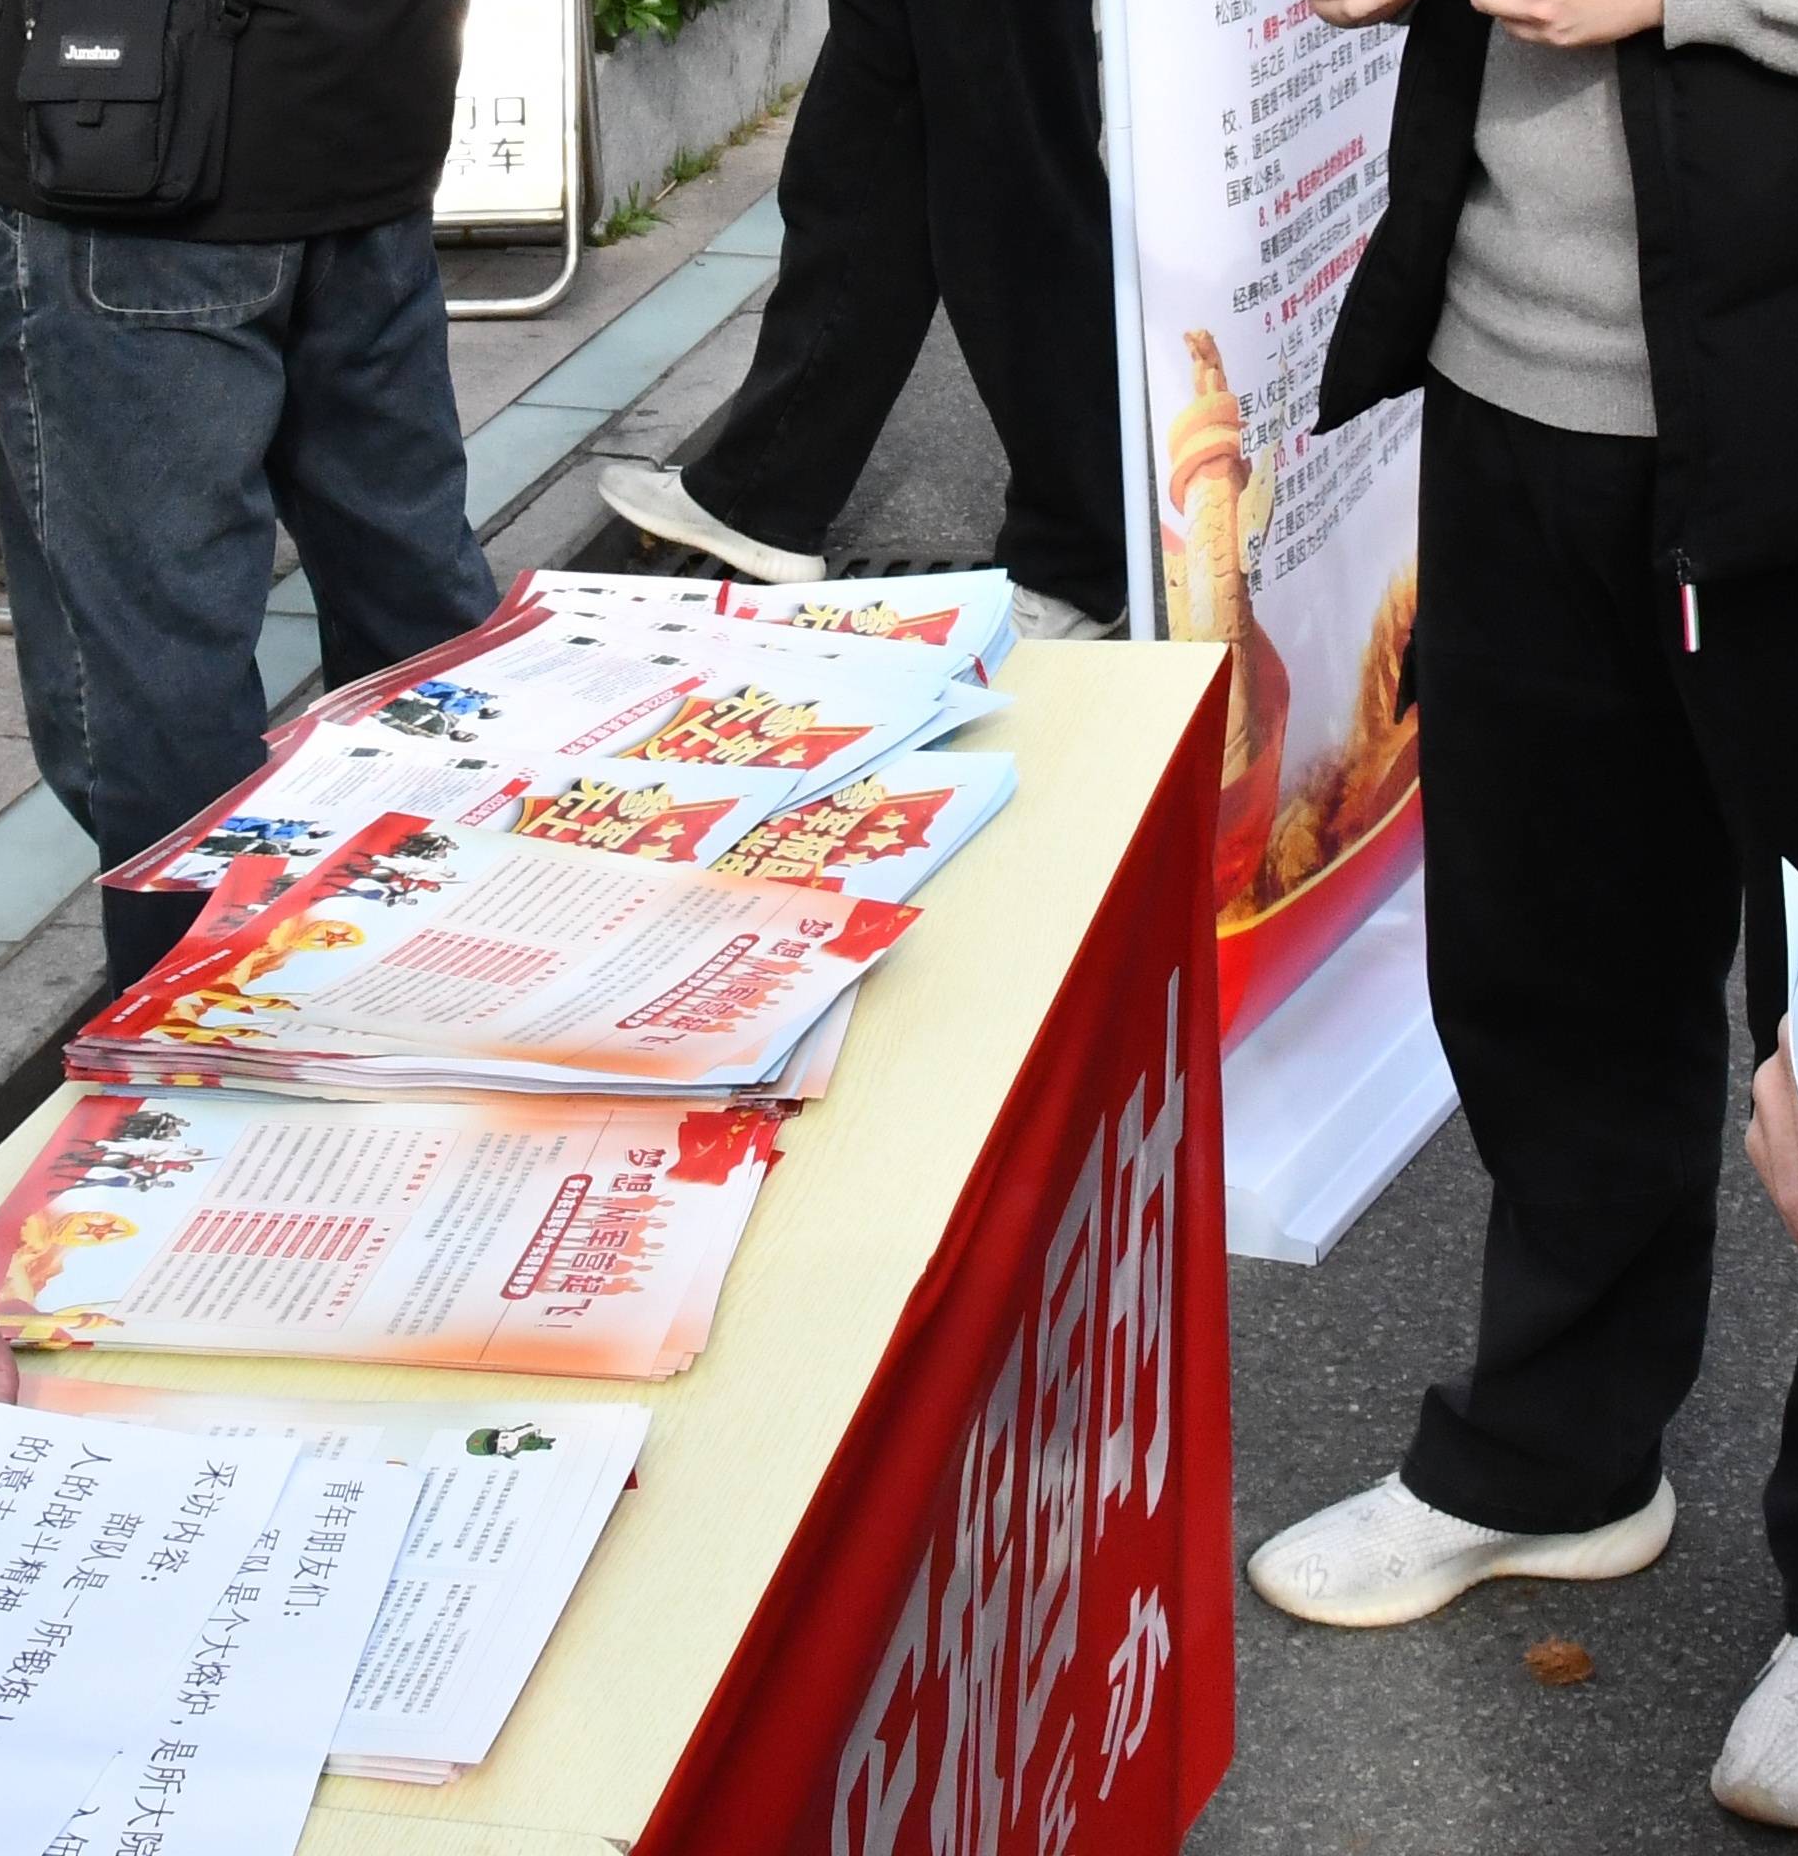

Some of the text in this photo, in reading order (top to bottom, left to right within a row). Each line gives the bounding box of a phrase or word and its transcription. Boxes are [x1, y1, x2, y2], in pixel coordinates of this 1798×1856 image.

[65, 45, 120, 60] Junshuo
[139, 1459, 239, 1583] 采访内容：
[283, 1479, 365, 1618] 青年朋友们：
